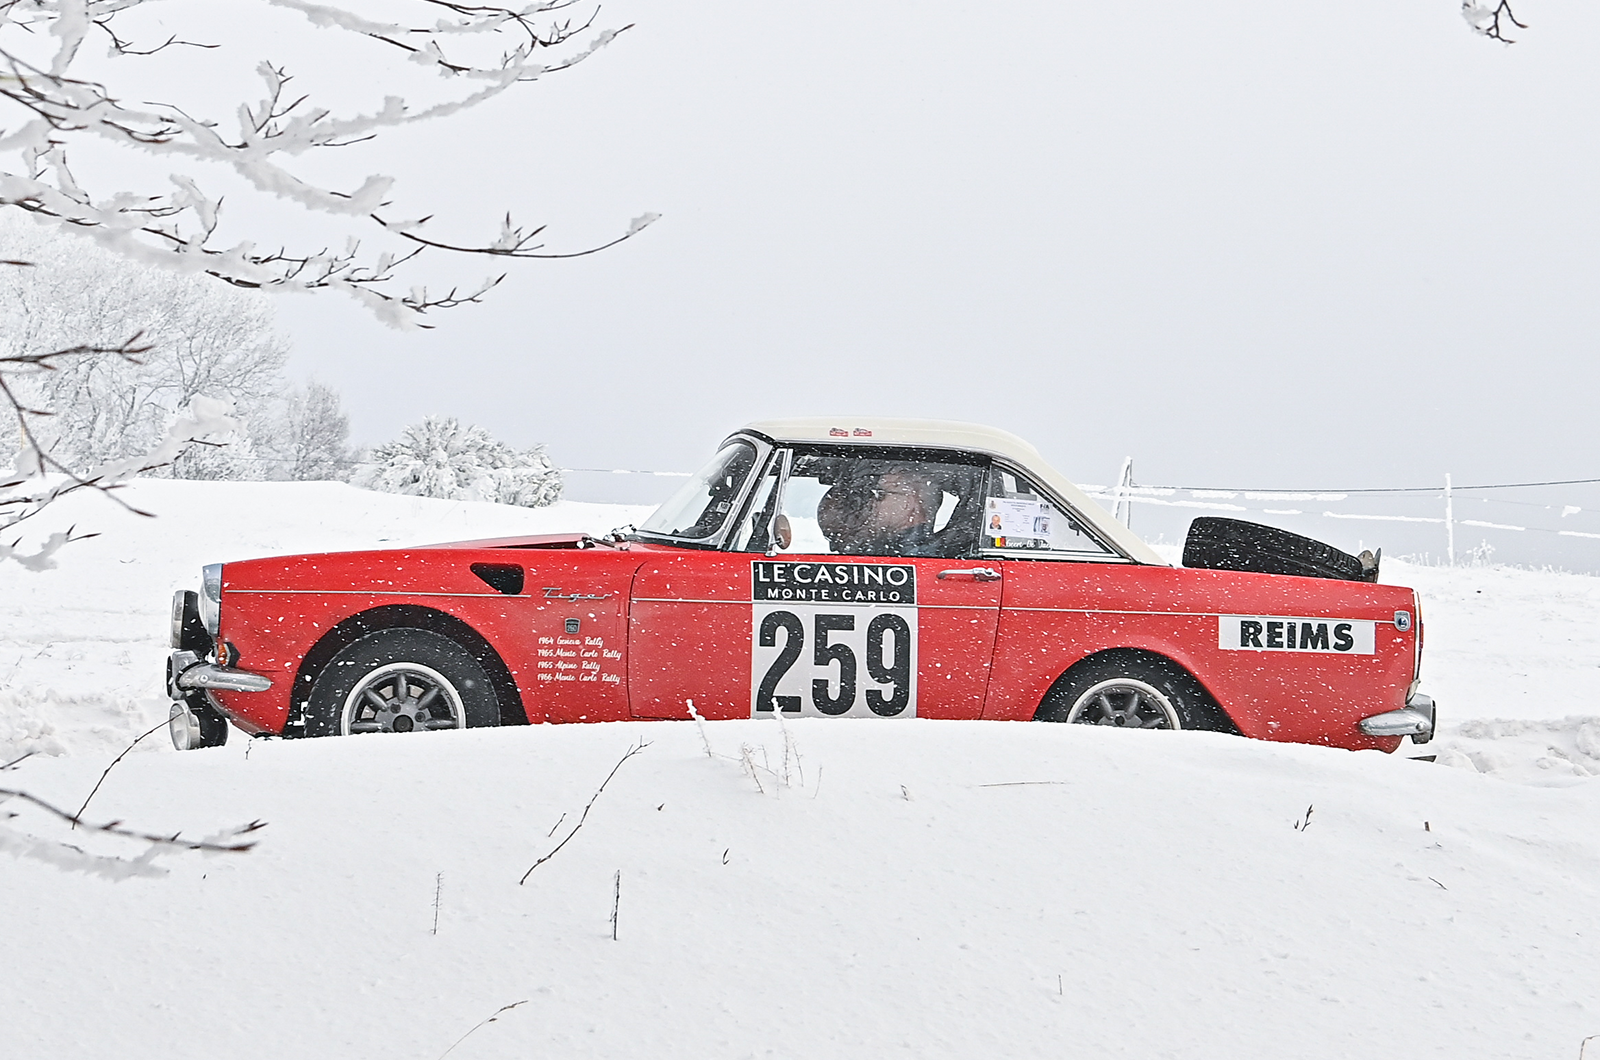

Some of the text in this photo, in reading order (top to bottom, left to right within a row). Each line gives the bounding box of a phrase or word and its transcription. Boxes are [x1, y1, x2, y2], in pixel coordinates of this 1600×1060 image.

[758, 563, 908, 586] LE CASINO
[541, 587, 612, 602] Tiger
[767, 588, 900, 602] MONTE CARLO
[538, 636, 604, 648] 1964 Geneva Rally
[1240, 620, 1354, 651] REIMS
[537, 648, 622, 661] 1965 Monte Carlo Rally
[537, 660, 601, 673] 1965 Alpine Rally
[756, 610, 911, 717] 259
[537, 672, 621, 685] 1966 Monte Carlo Rally
